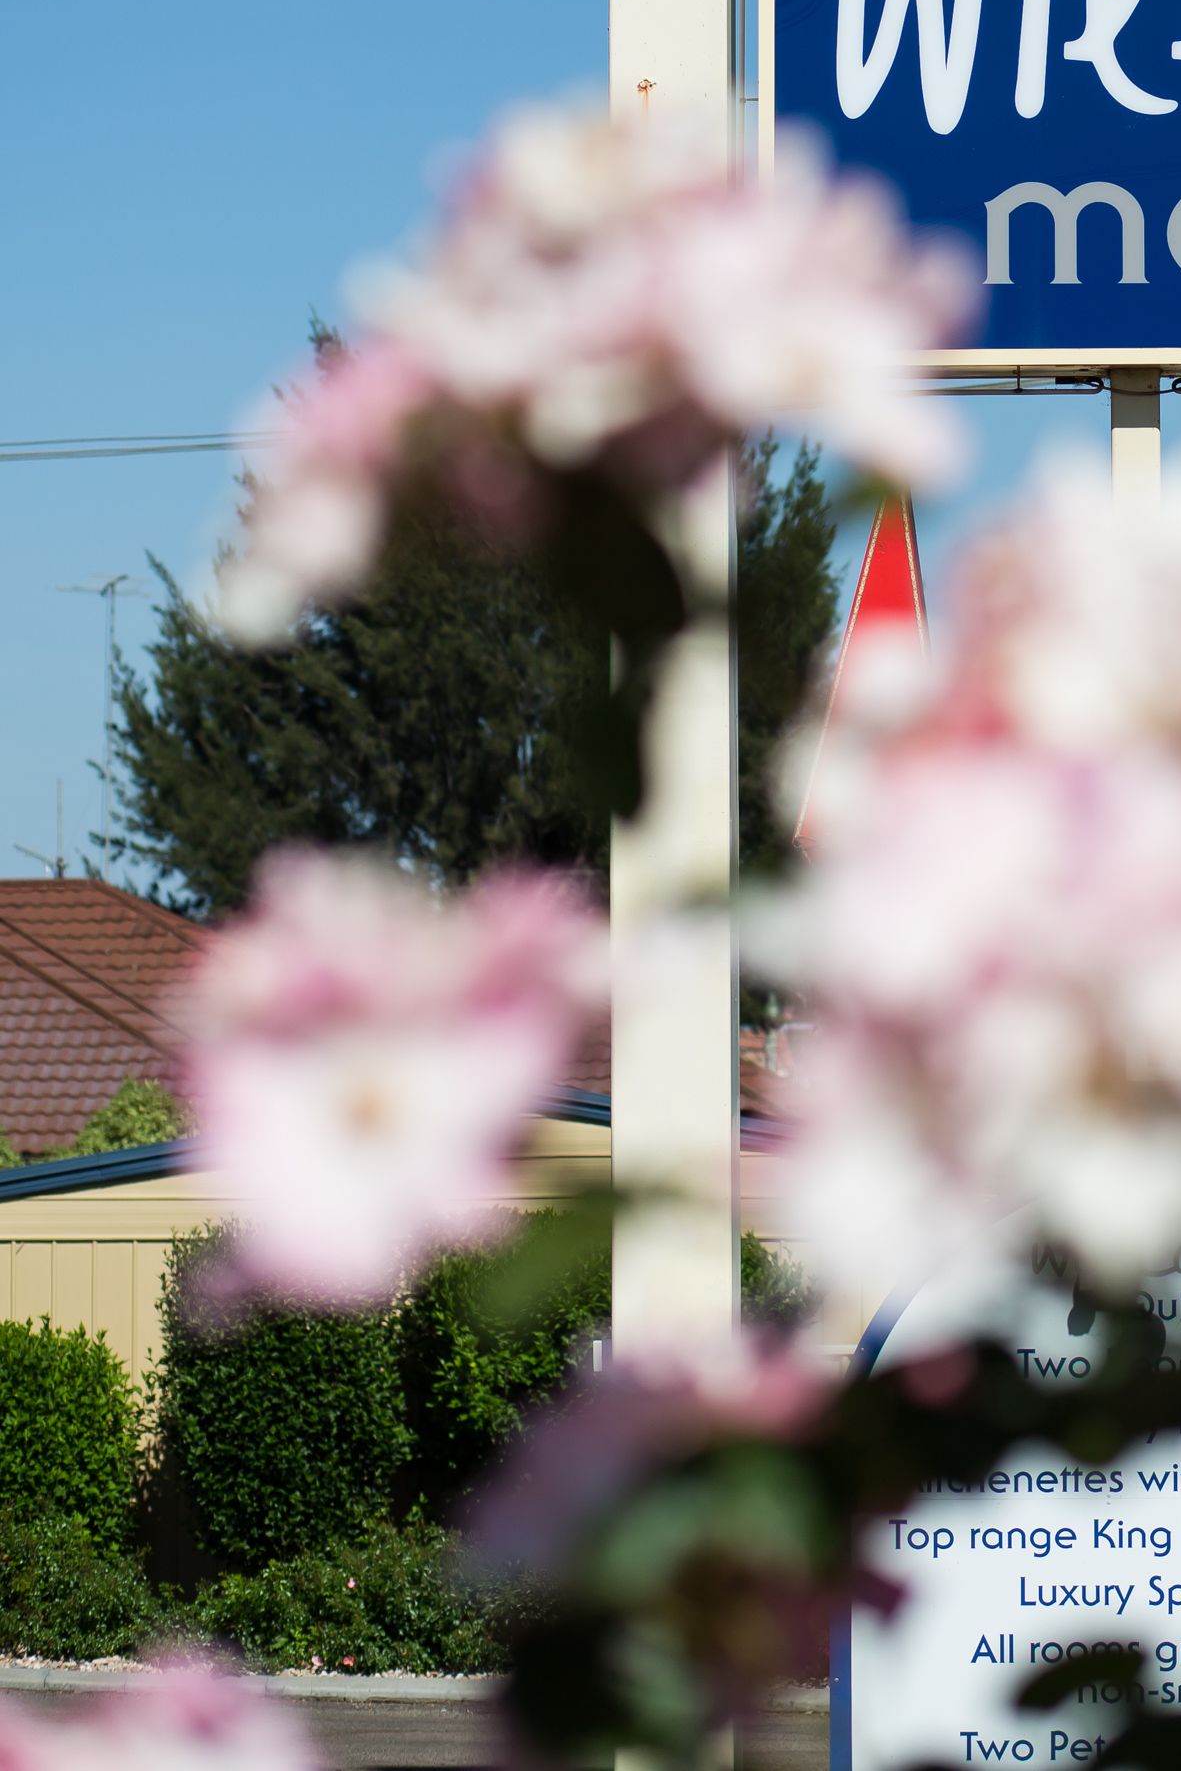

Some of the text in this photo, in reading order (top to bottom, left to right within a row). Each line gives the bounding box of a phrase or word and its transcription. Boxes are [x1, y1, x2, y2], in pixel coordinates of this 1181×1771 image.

[1017, 1349, 1091, 1379] Two
[889, 1519, 955, 1558] Top
[970, 1527, 1077, 1558] range
[1093, 1519, 1173, 1557] King
[1019, 1577, 1135, 1615] Luxury
[970, 1634, 1015, 1664] All
[960, 1731, 1034, 1763] Two
